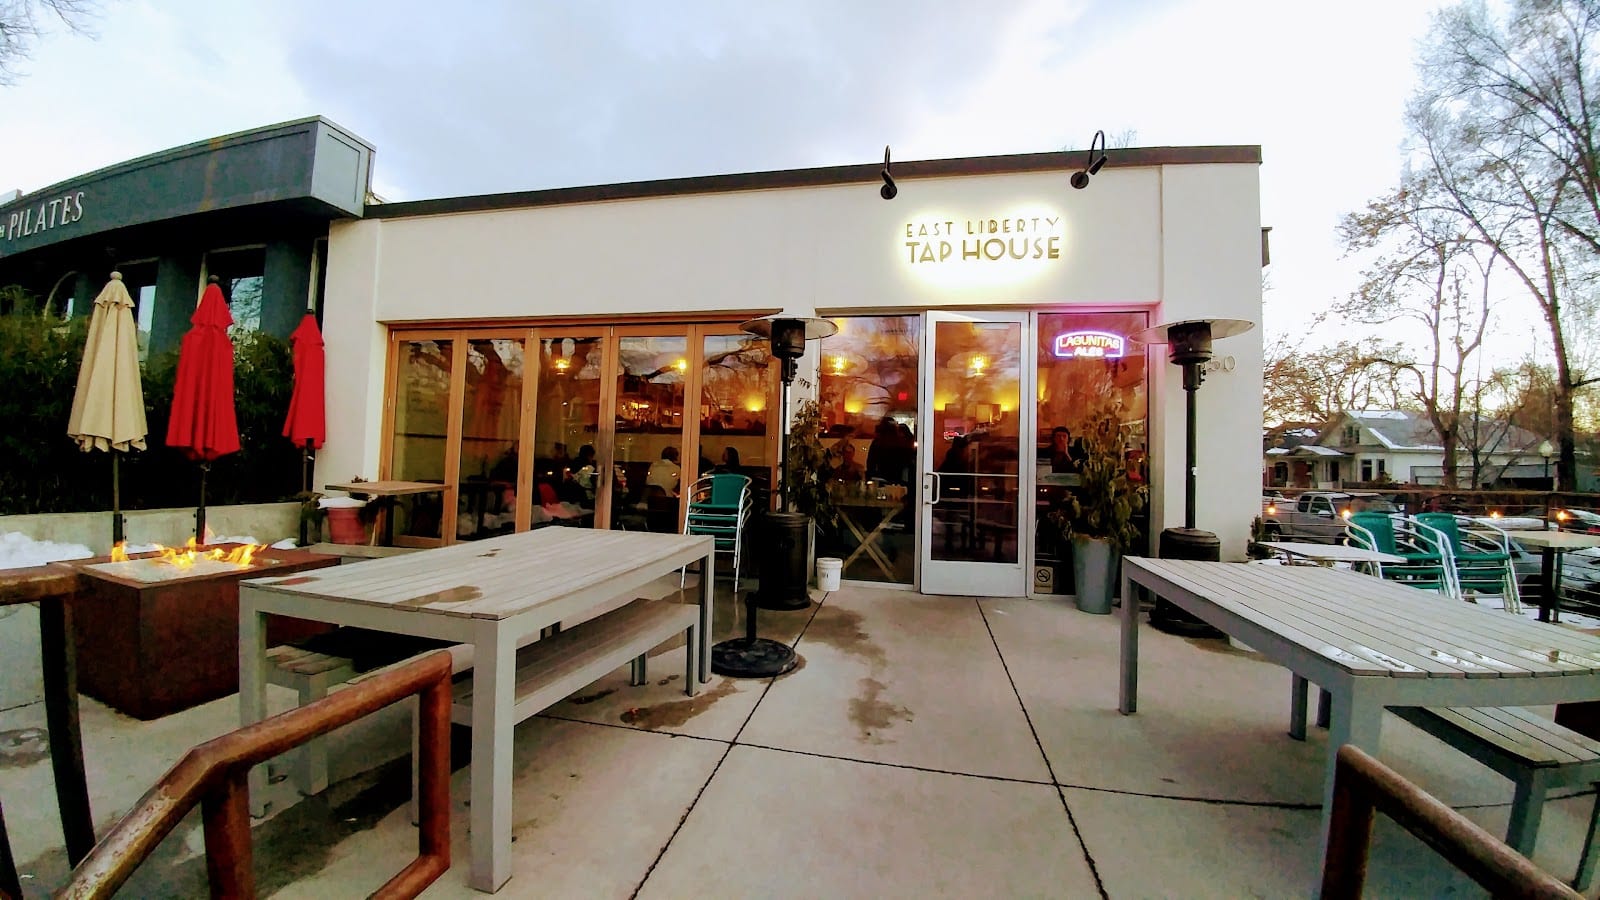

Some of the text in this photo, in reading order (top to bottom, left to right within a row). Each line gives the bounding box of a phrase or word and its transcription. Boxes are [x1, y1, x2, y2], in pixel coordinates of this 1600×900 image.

[7, 191, 85, 241] PILATES
[906, 216, 1060, 238] EAST LIBERTY
[905, 236, 1060, 264] TAP HOUSE
[1060, 335, 1120, 349] LAGUNITAS
